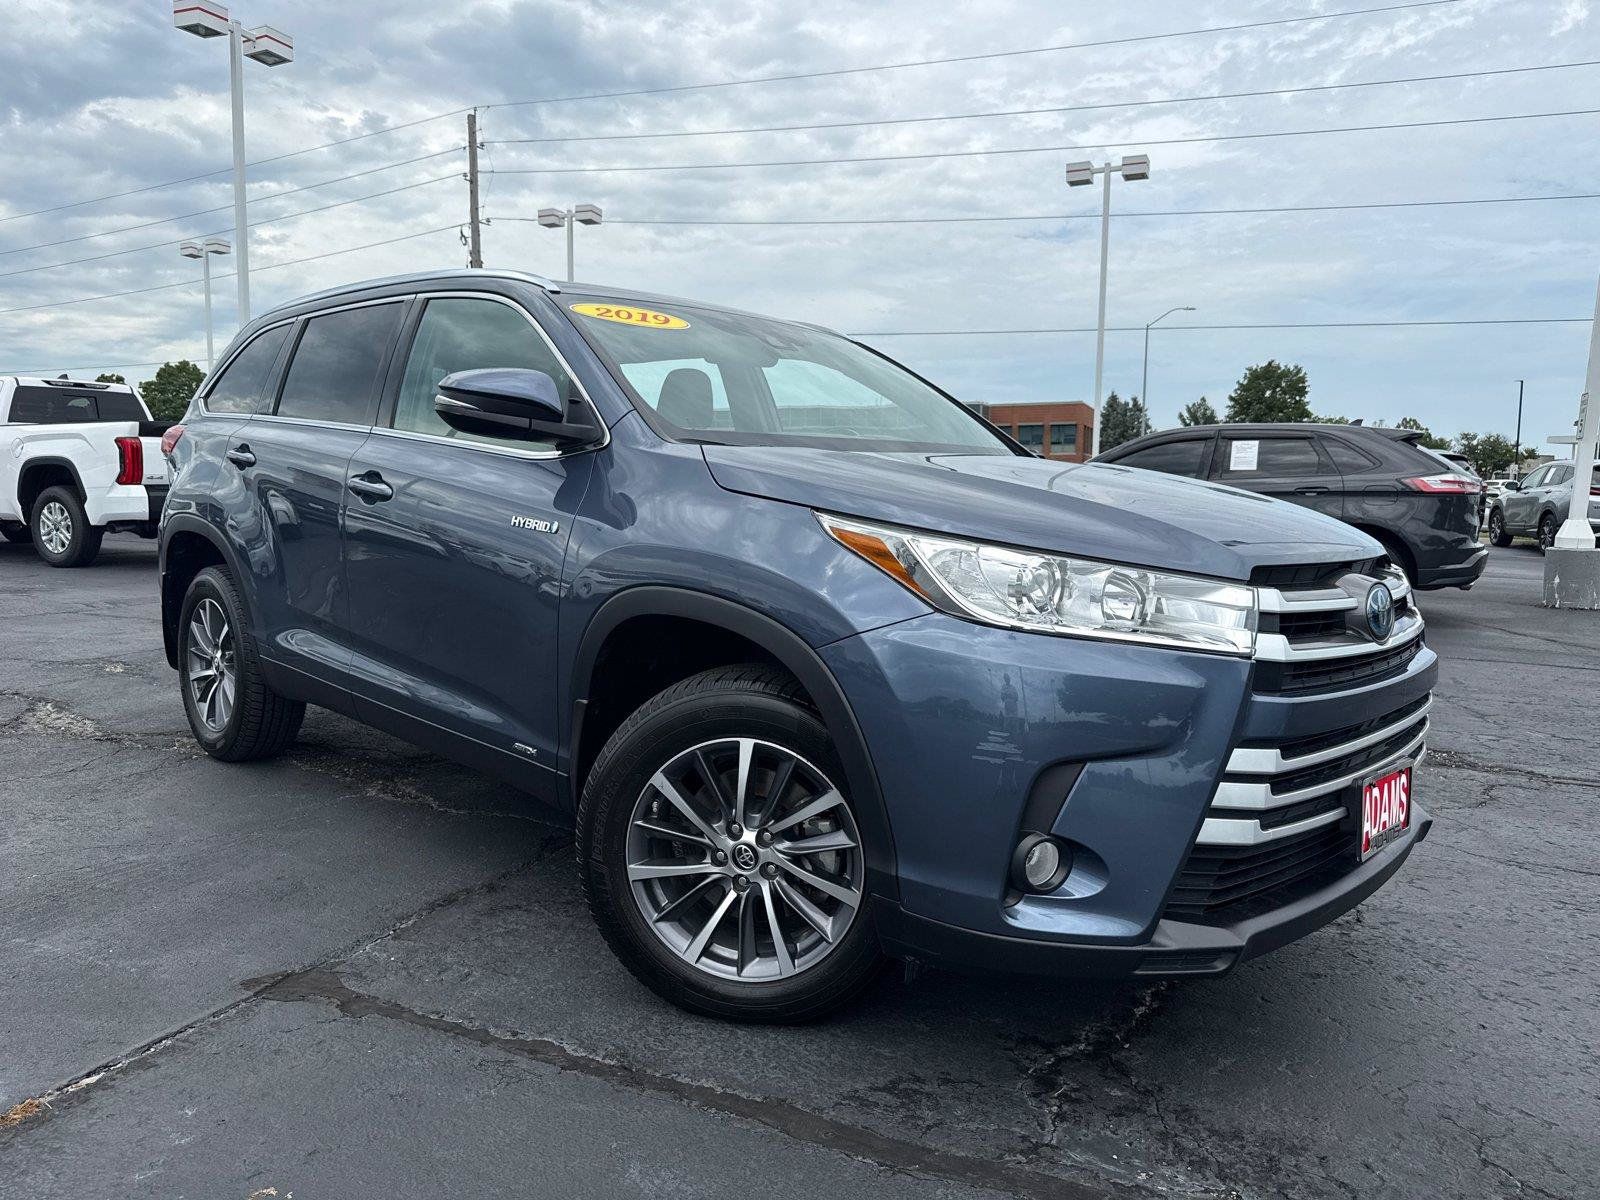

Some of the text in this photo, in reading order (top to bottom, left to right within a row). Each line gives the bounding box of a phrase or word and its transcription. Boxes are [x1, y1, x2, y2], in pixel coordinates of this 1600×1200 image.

[595, 307, 670, 325] 2019
[511, 515, 551, 532] HYBRID
[1362, 773, 1407, 851] ADAMS
